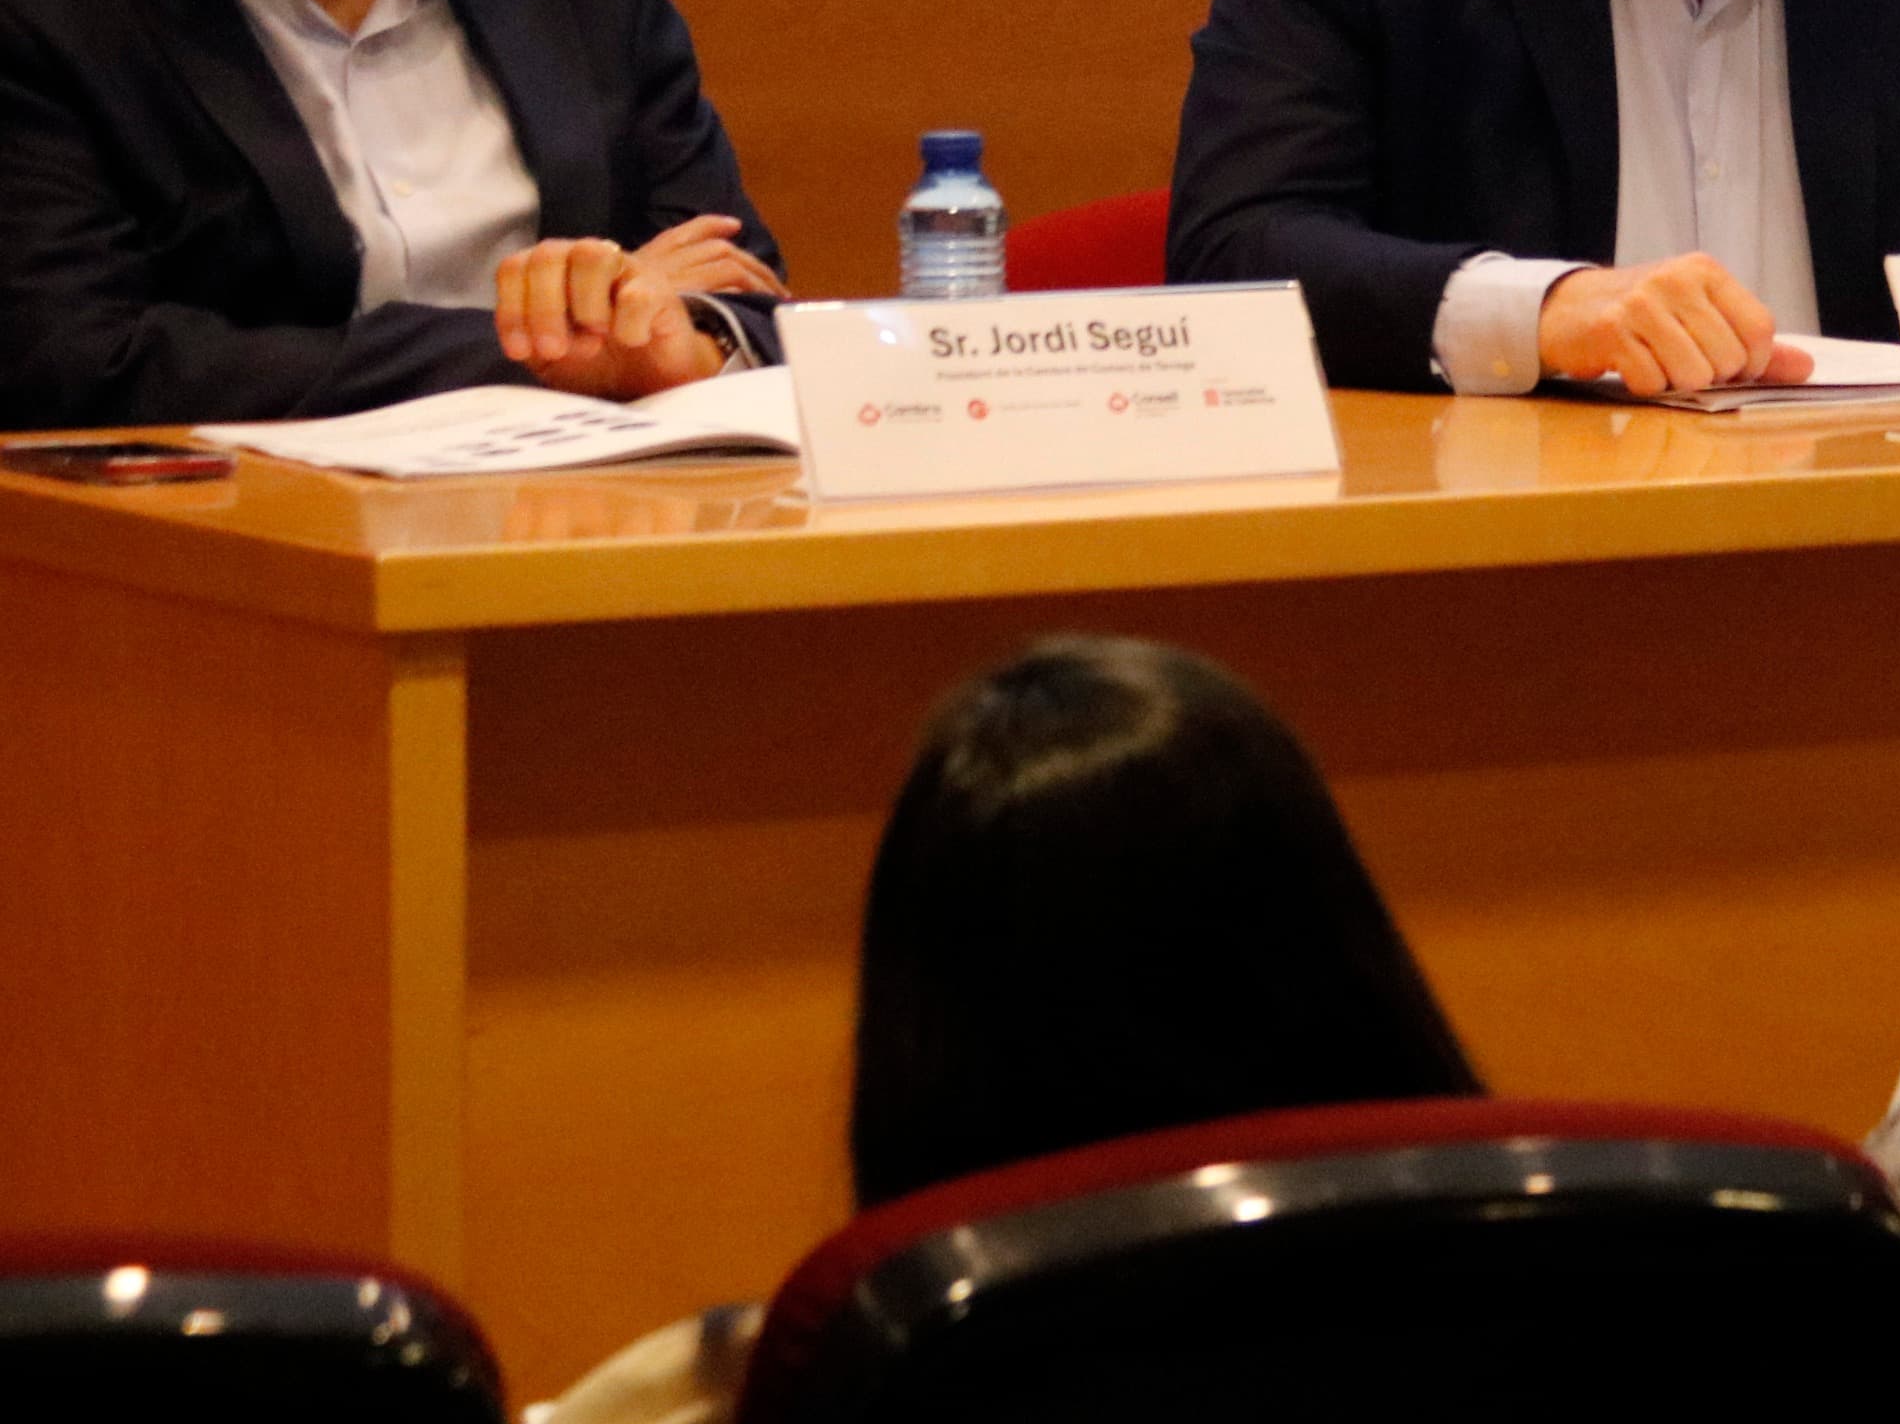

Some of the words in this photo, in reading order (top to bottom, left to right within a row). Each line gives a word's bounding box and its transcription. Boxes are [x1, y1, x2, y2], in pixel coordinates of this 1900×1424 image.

[928, 326, 979, 359] Sr.
[989, 322, 1079, 356] Jordi
[1086, 316, 1191, 357] Seguí
